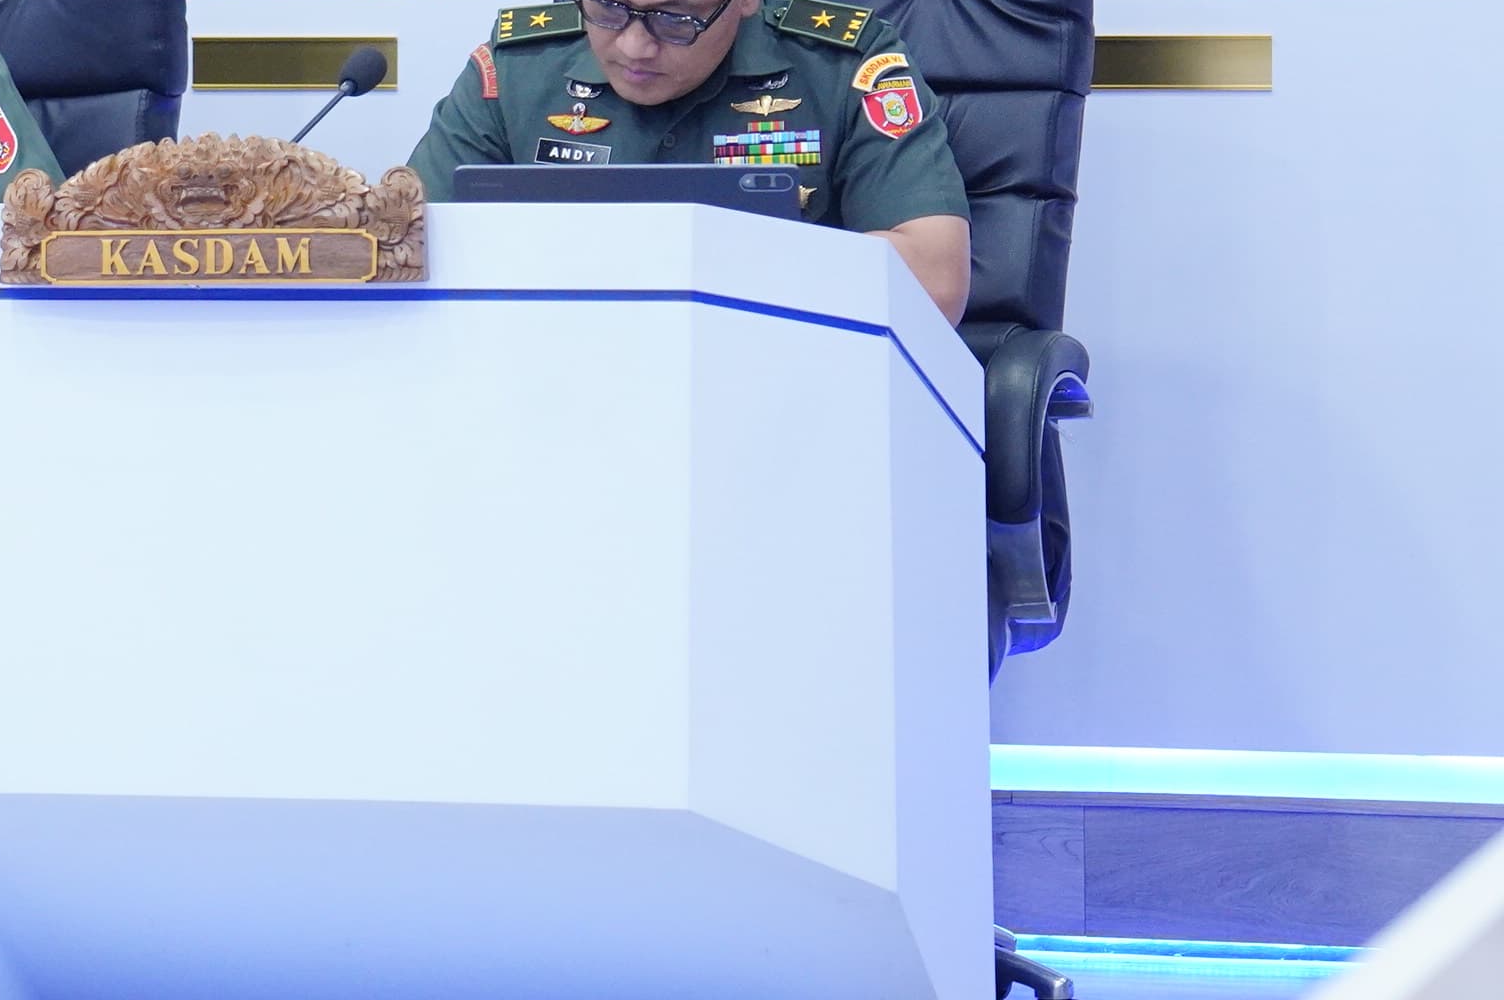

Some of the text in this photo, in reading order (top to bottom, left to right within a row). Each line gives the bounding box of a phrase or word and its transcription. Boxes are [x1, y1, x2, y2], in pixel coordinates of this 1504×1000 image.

[500, 10, 513, 38] TNI
[843, 11, 867, 41] TNI
[549, 146, 595, 162] ANDY
[100, 236, 314, 276] KASDAM
